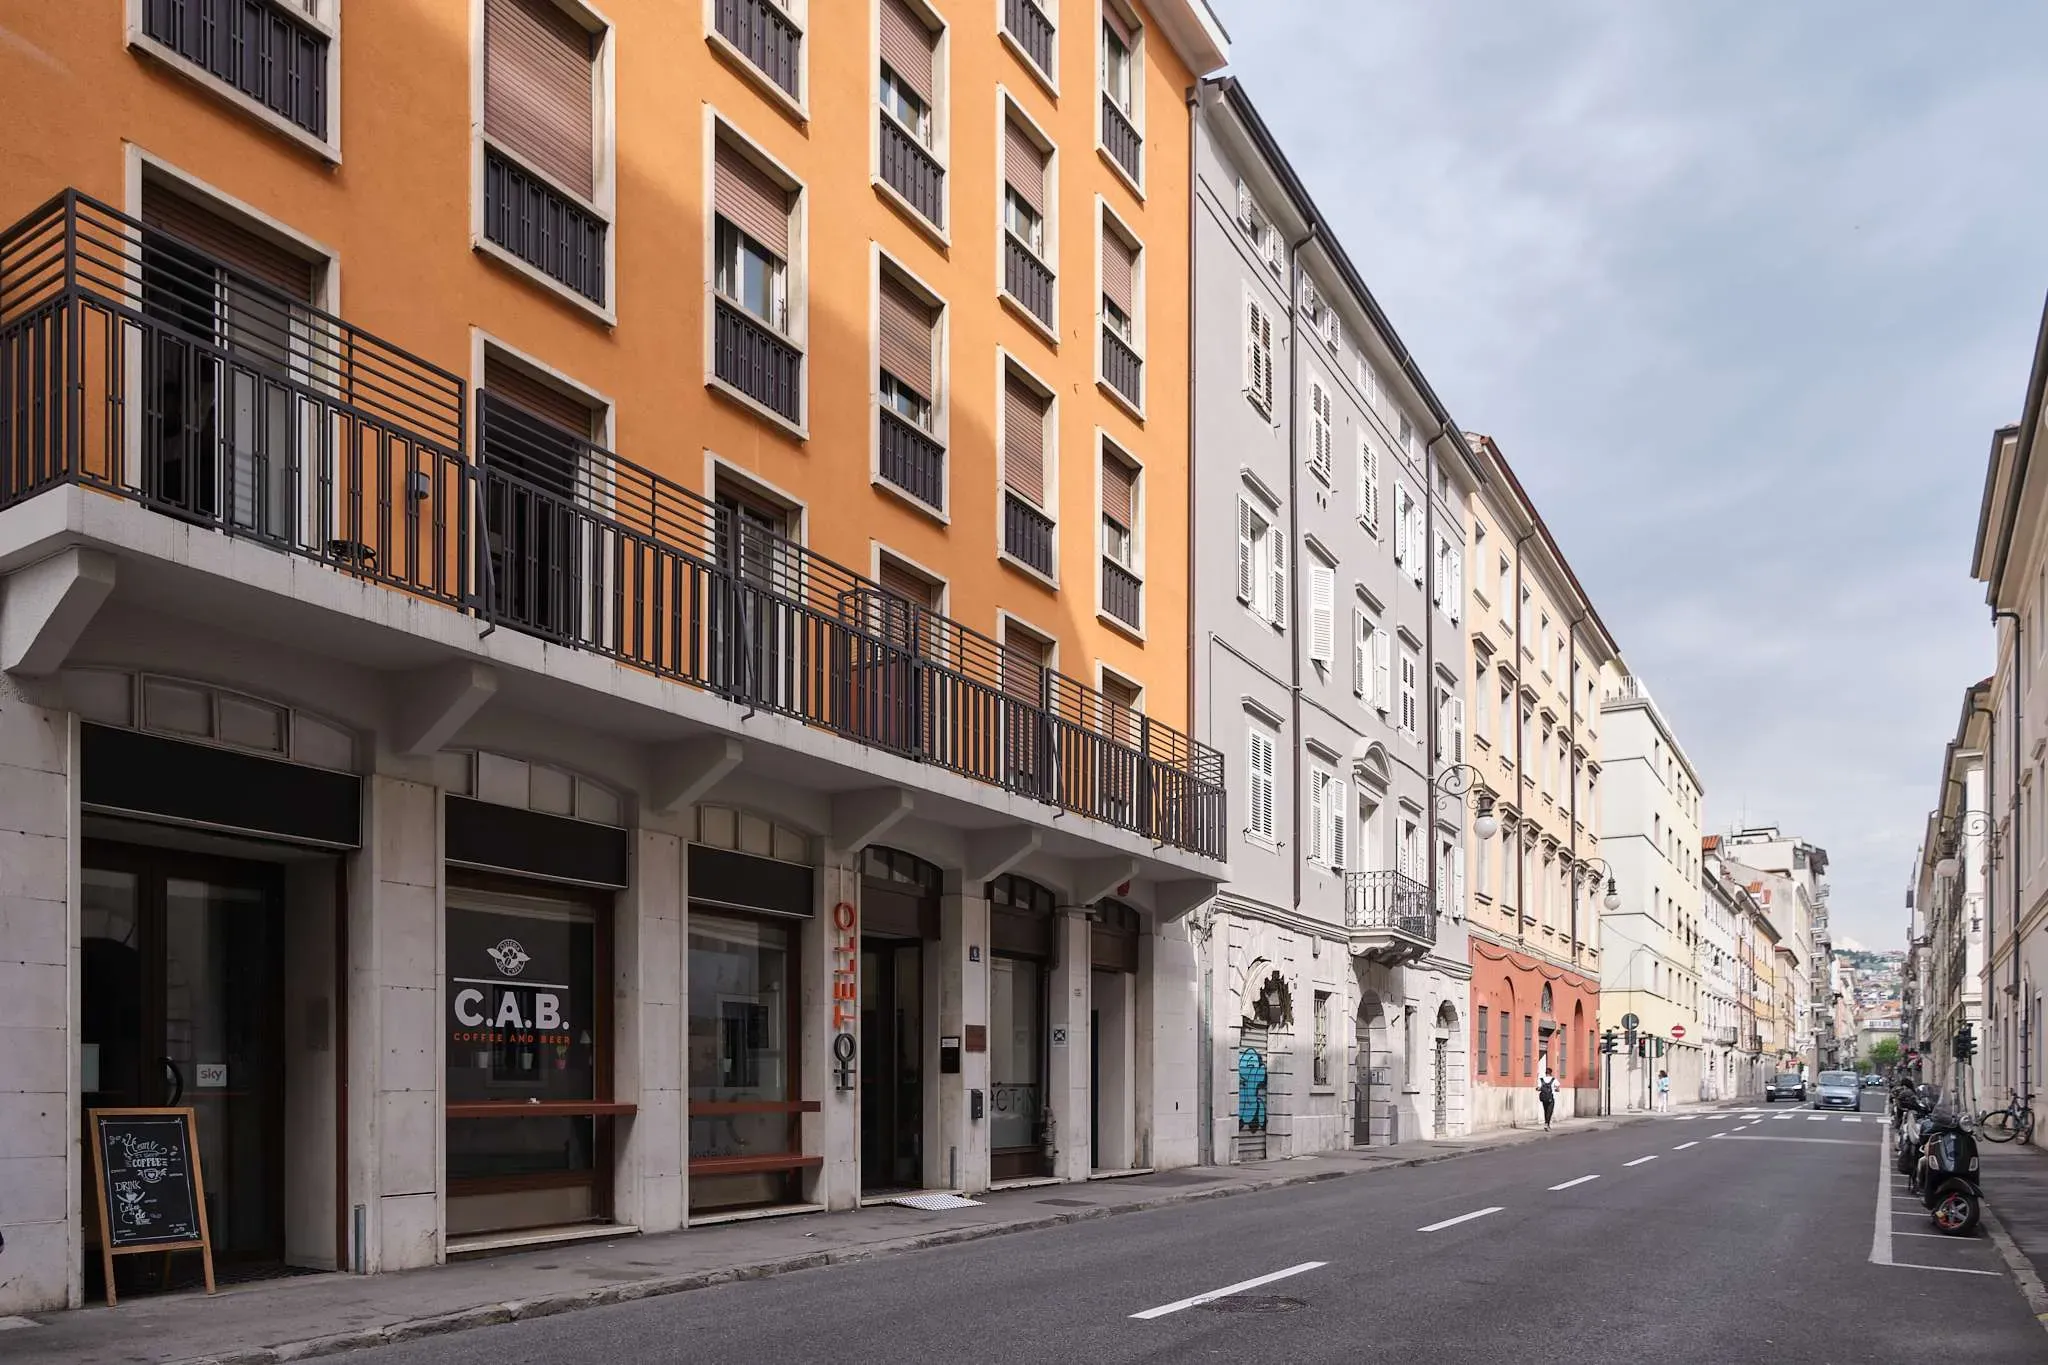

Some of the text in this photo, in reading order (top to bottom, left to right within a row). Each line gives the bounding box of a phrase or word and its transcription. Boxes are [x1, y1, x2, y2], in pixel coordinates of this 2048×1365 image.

[454, 988, 570, 1030] C.A.B.
[453, 1032, 571, 1045] COFFEE AND BEER
[200, 1068, 223, 1082] sky
[132, 1157, 162, 1168] COFFEE
[114, 1179, 142, 1192] DRINK
